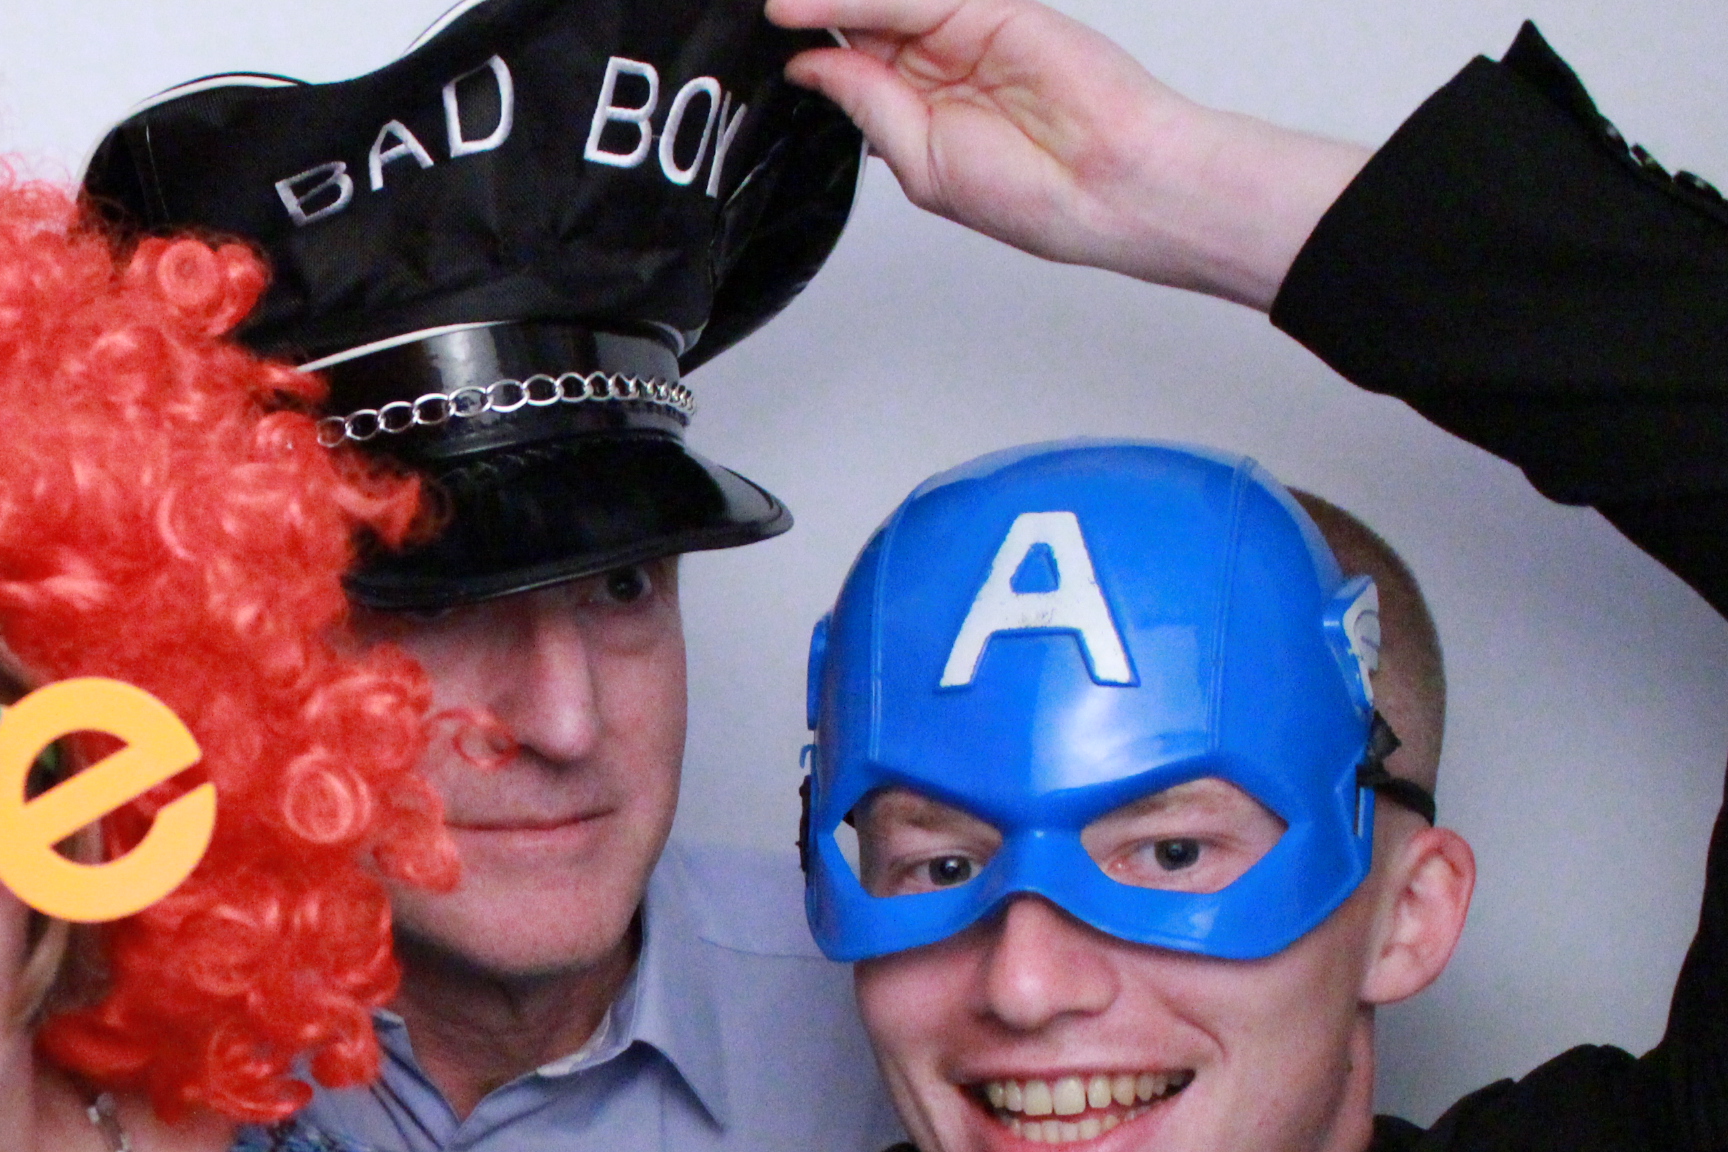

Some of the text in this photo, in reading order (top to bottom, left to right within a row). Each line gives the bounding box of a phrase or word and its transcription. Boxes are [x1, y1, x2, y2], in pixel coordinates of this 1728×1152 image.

[275, 54, 747, 227] BAD BOY
[938, 511, 1136, 688] A
